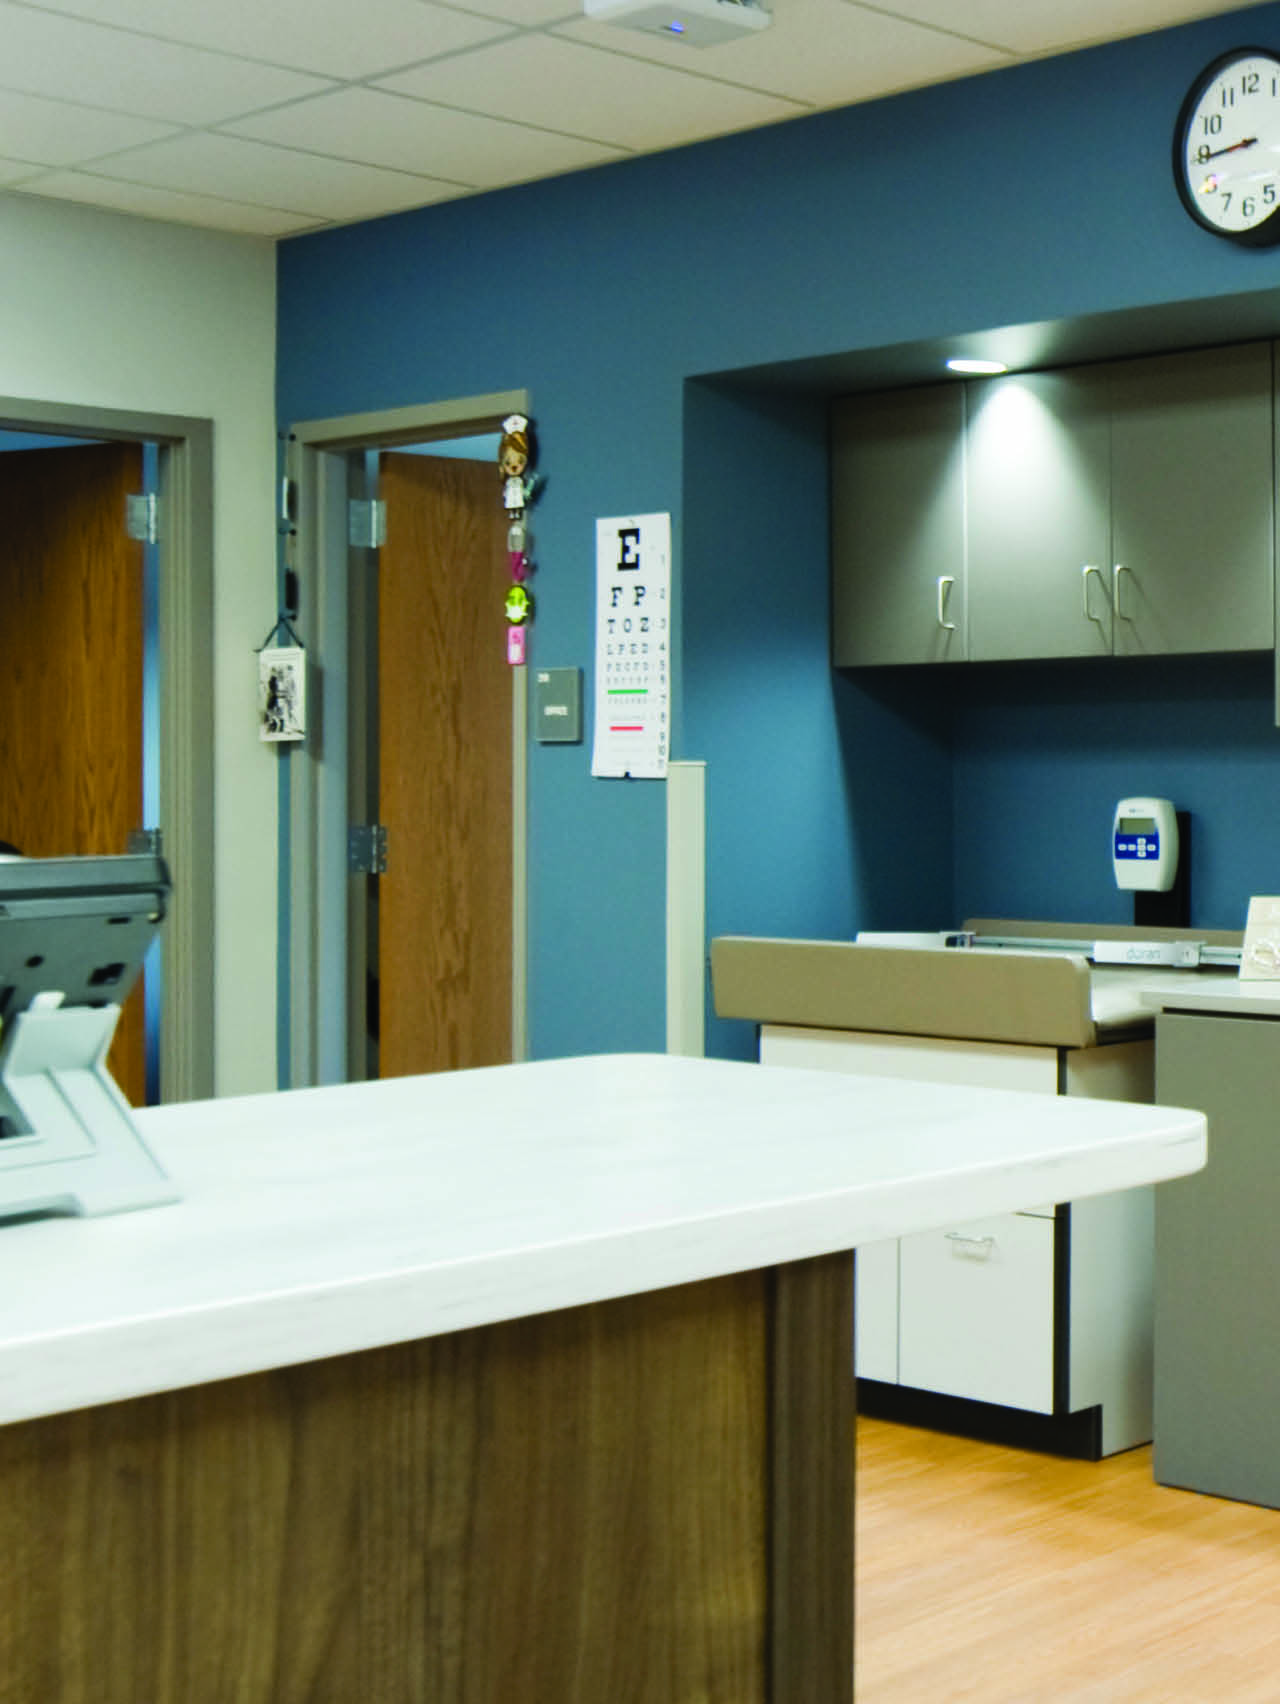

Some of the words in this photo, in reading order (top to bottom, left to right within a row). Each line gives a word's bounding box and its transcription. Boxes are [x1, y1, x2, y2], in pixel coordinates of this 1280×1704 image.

[1242, 73, 1260, 95] 12
[1271, 77, 1277, 97] 1
[1222, 87, 1235, 108] 11
[1204, 114, 1223, 136] 10
[1221, 192, 1232, 212] 7
[1263, 184, 1275, 204] 5
[1242, 197, 1255, 217] 6
[616, 527, 641, 572] E
[632, 584, 647, 607] P
